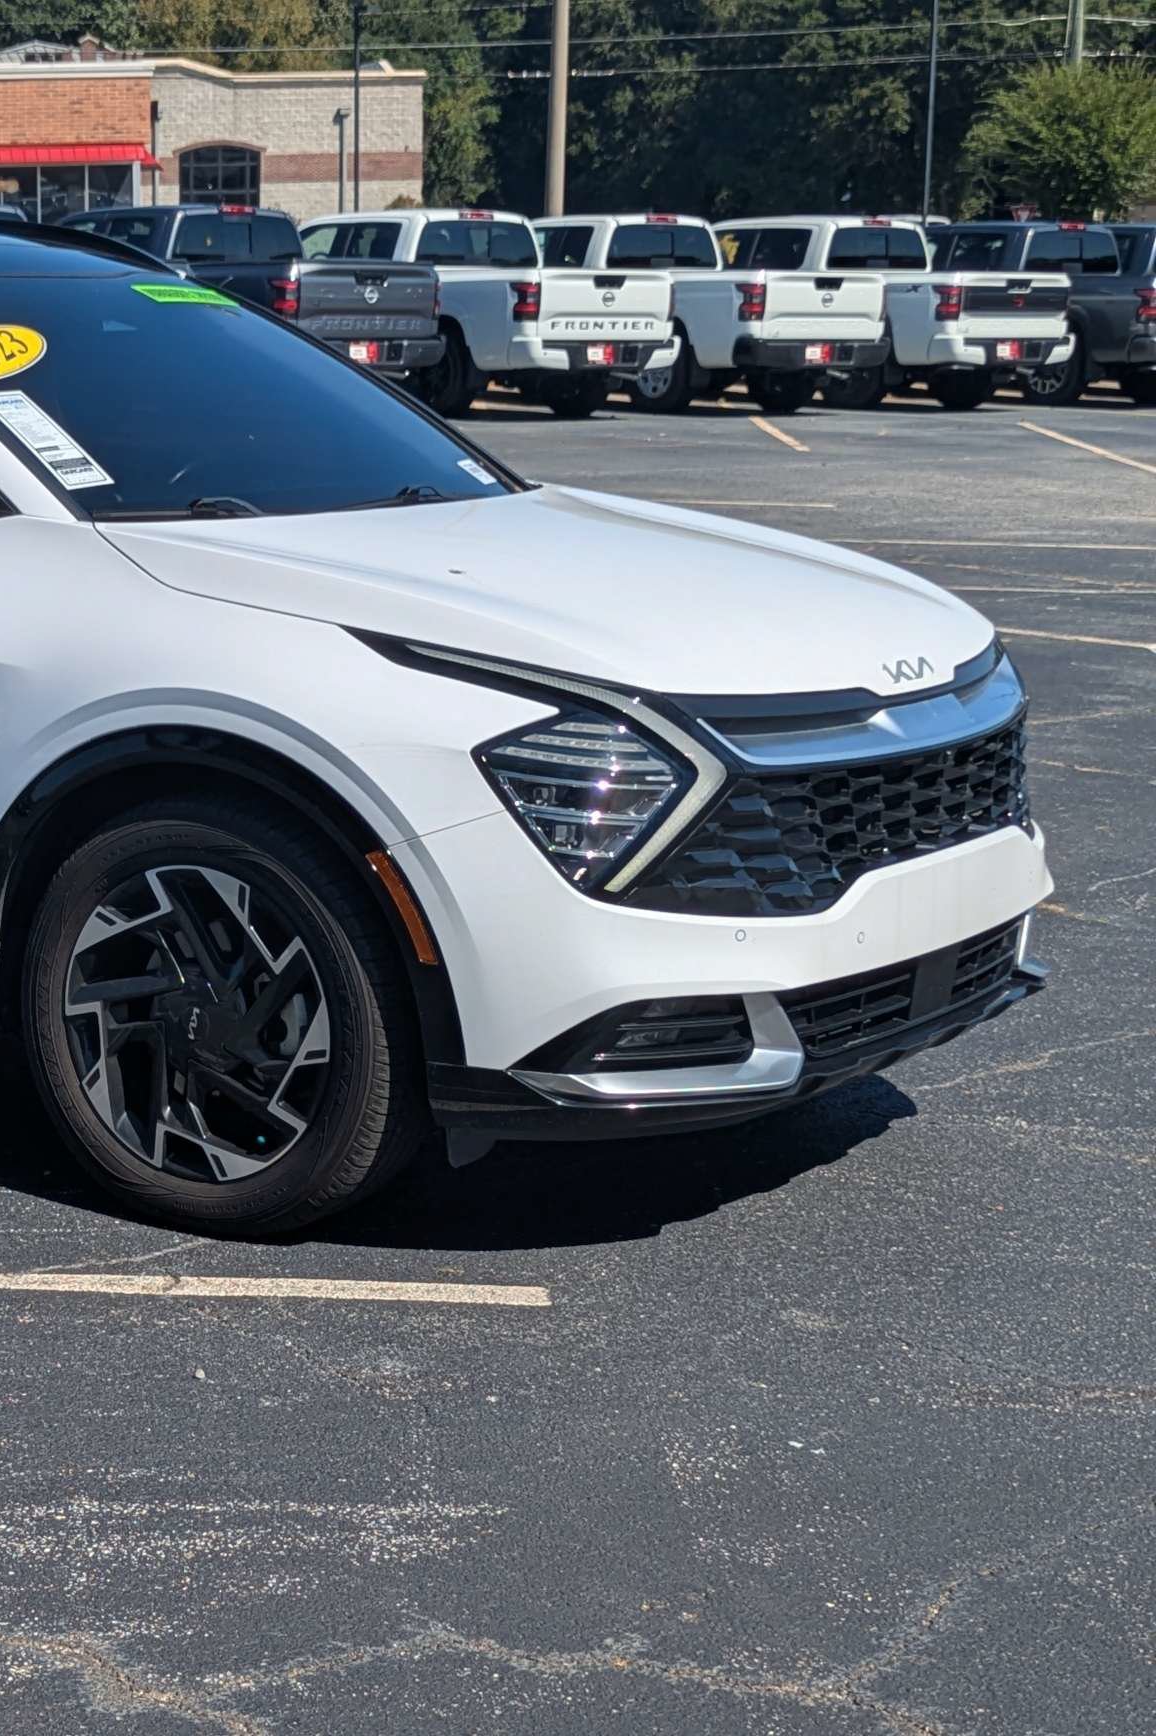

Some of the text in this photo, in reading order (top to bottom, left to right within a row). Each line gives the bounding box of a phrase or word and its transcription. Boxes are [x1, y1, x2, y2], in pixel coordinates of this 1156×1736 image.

[310, 318, 422, 330] FRONTIER
[550, 321, 655, 331] FRONTIER
[882, 656, 935, 684] KIA
